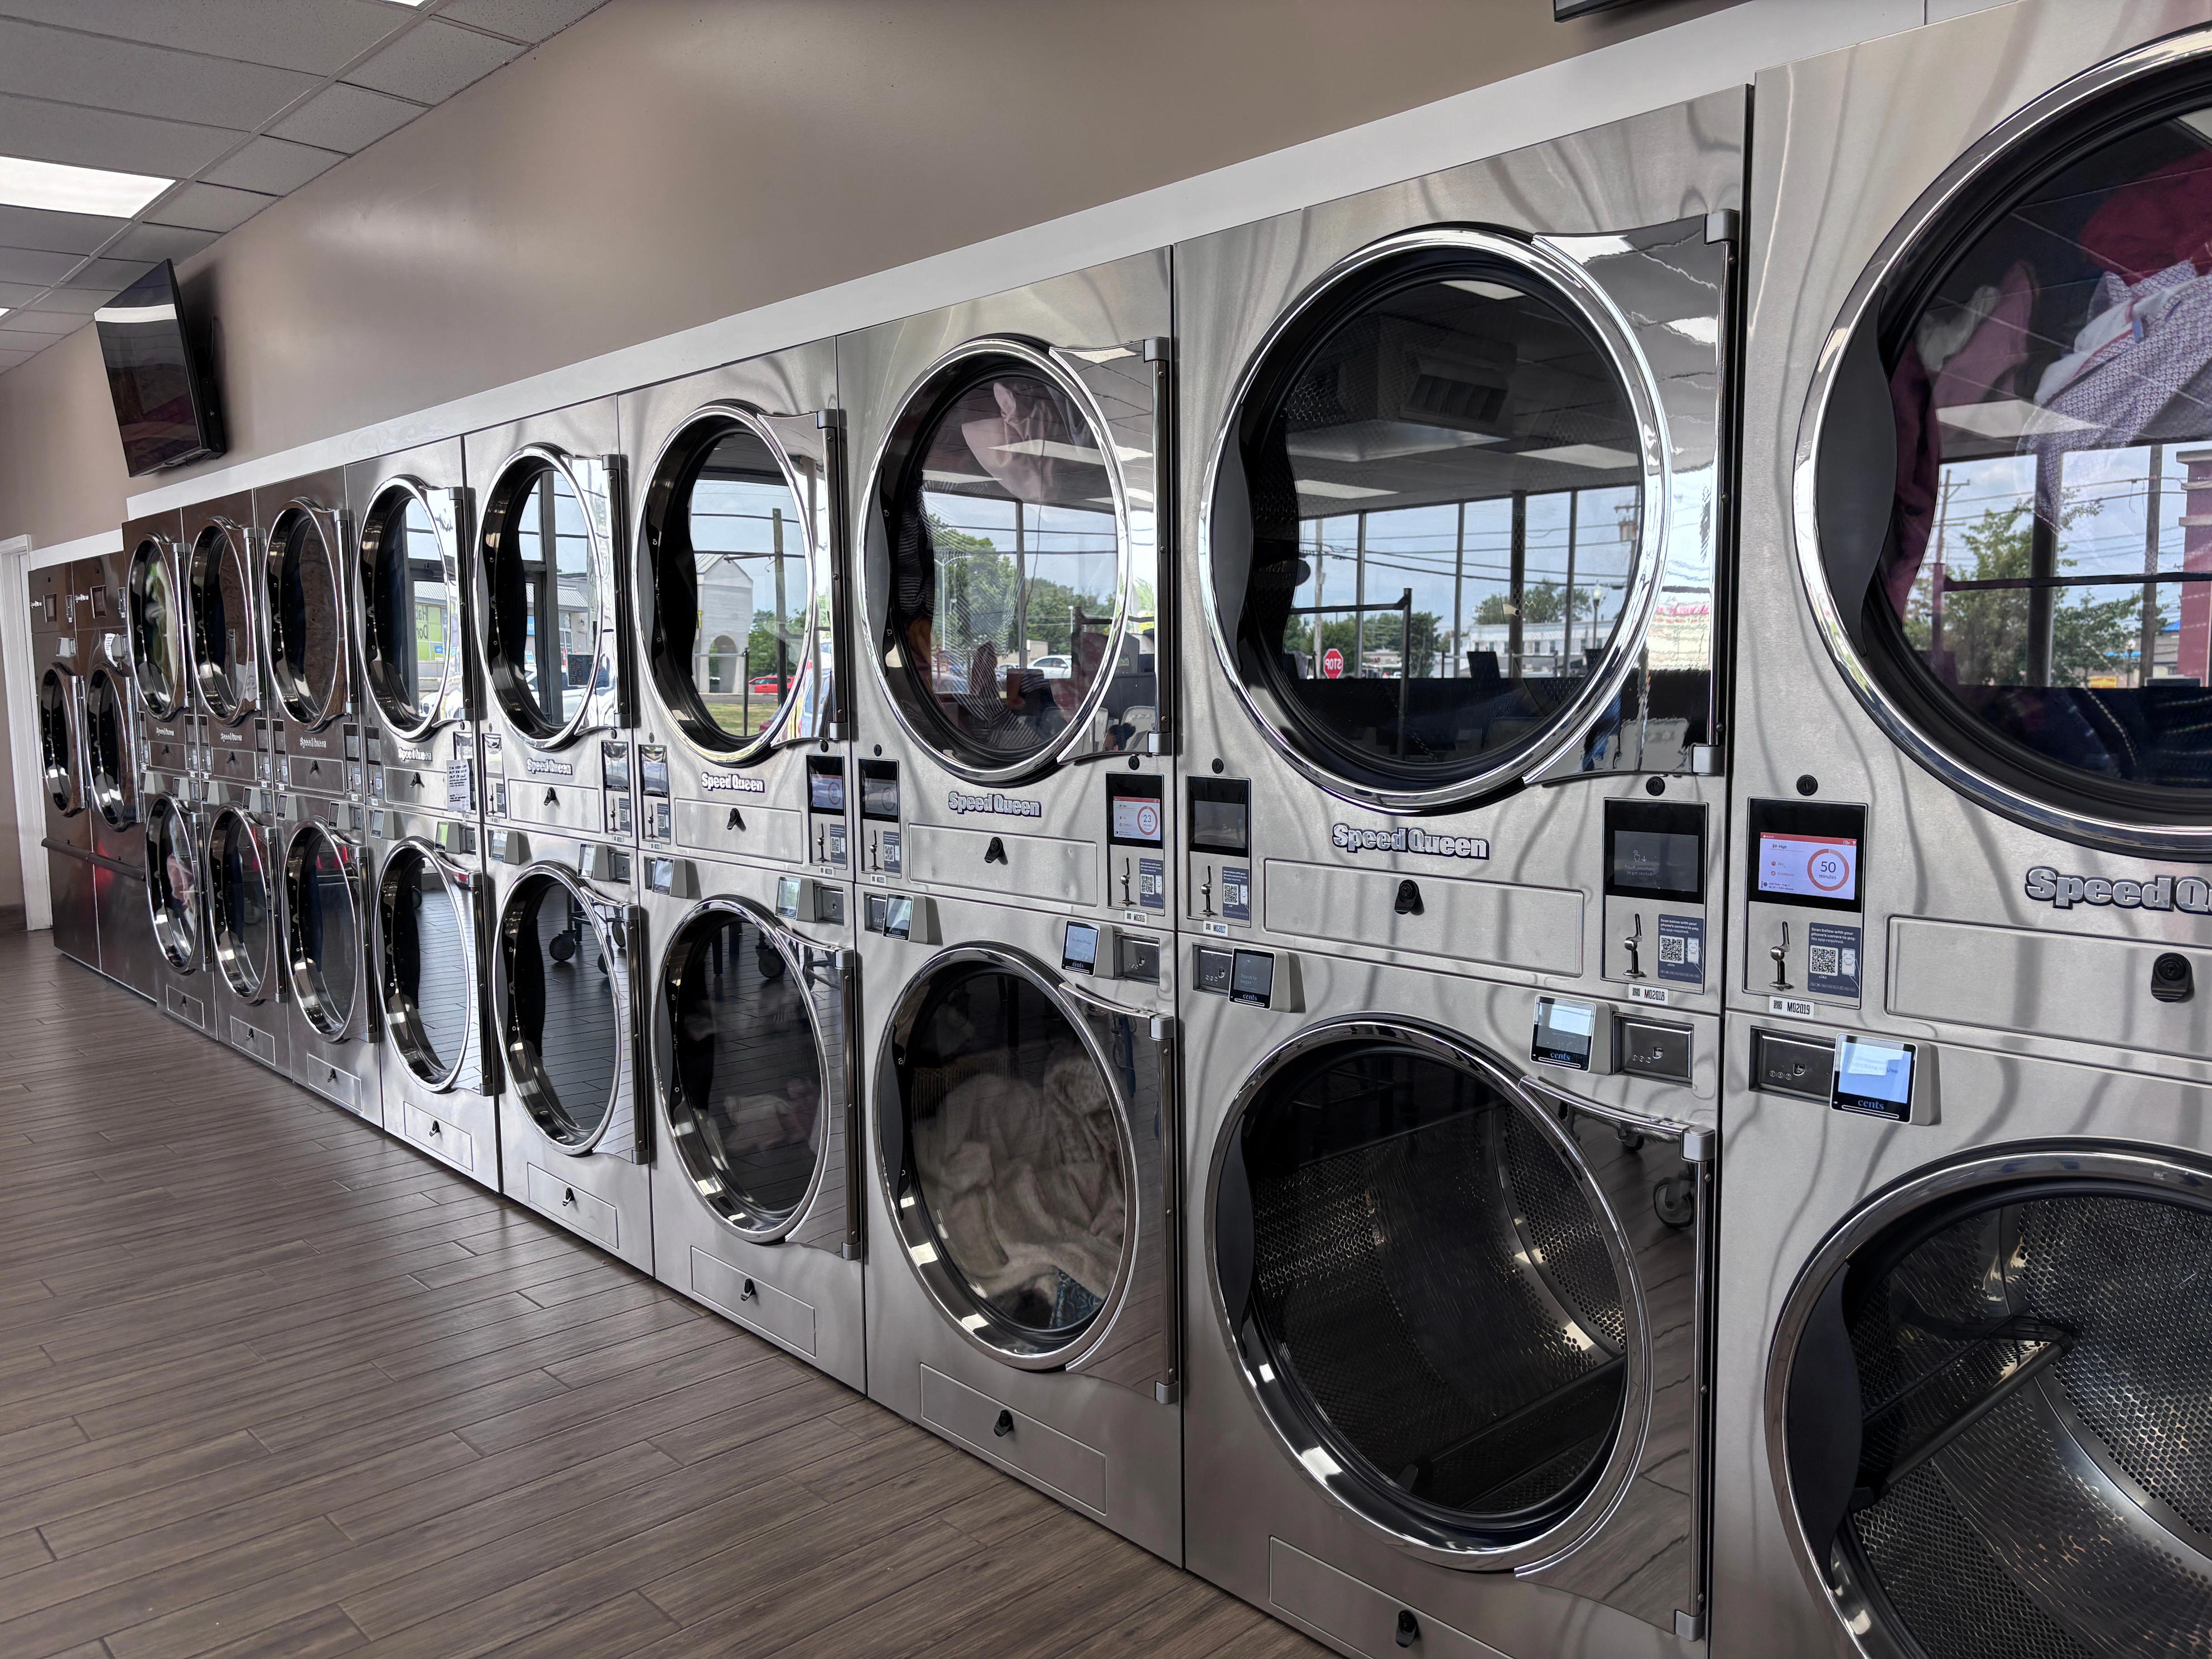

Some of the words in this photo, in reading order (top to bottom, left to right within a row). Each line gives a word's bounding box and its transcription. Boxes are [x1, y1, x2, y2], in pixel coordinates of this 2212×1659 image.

[527, 758, 549, 774] Speed
[548, 759, 572, 775] Queen
[701, 772, 733, 791] Speed
[732, 774, 765, 793] Queen
[948, 791, 995, 814] Speed
[994, 794, 1042, 817] Queen
[1143, 814, 1151, 823] 23
[1332, 823, 1408, 852] Speed
[1408, 827, 1489, 860] Queen
[1820, 861, 1837, 873] 50
[2025, 866, 2175, 910] Speed
[1644, 988, 1665, 1001] M02018
[1787, 1001, 1810, 1015] M02019
[1550, 1052, 1570, 1060] cents
[1858, 1098, 1885, 1110] cents
